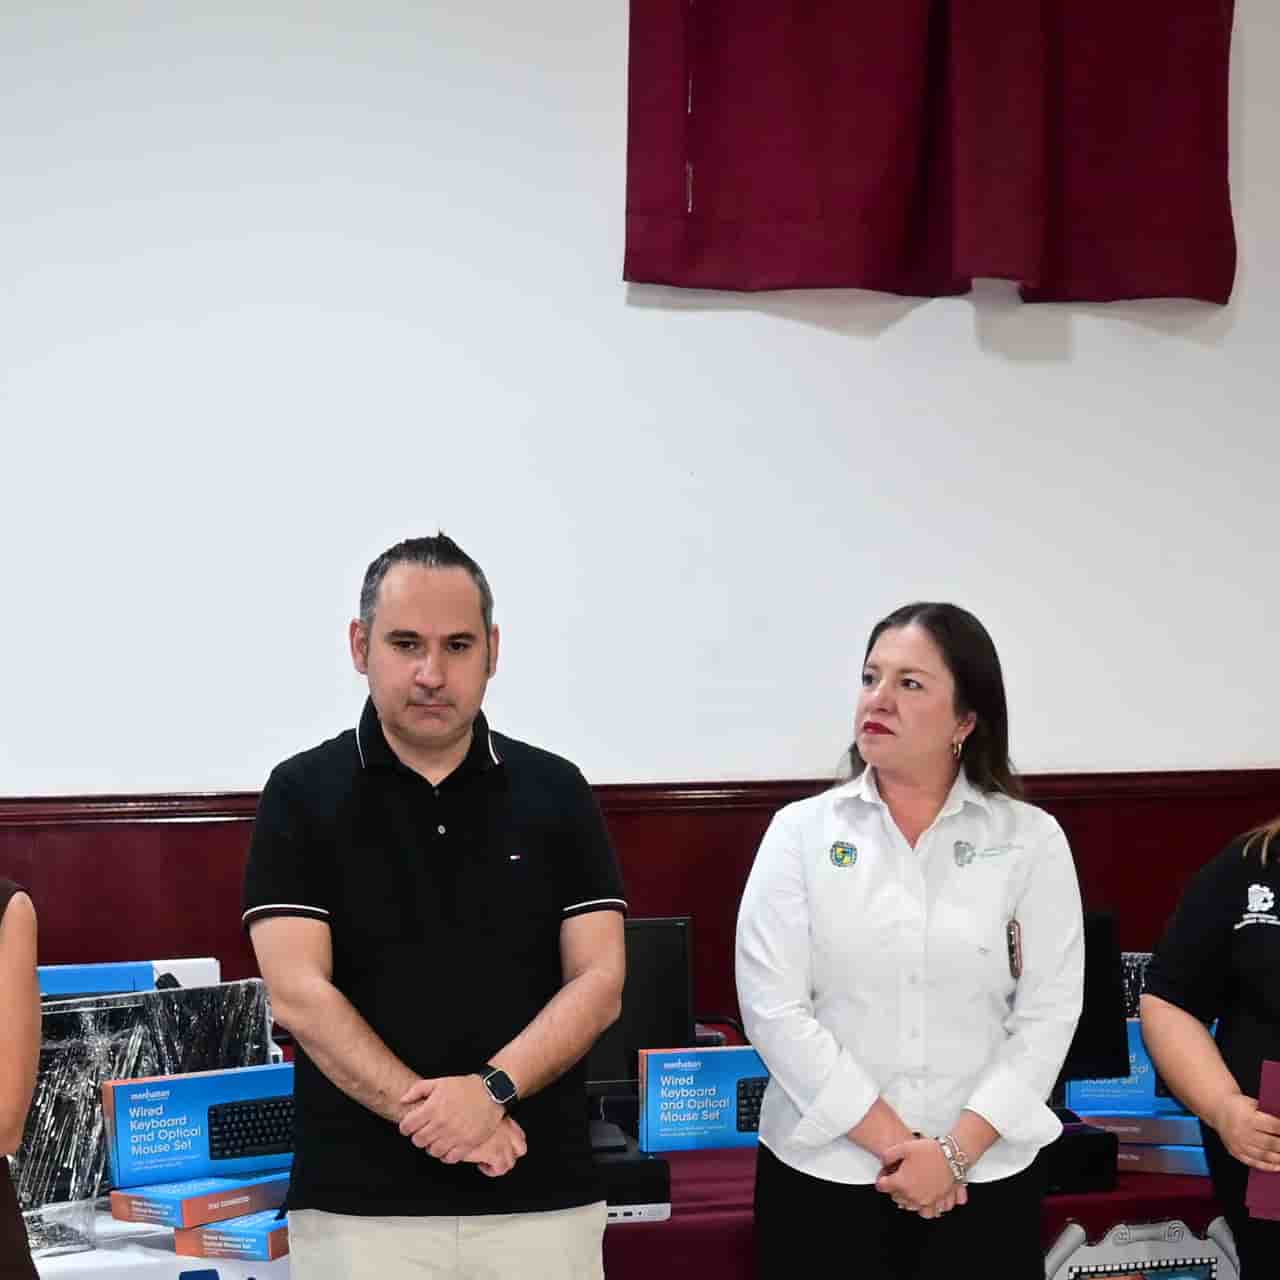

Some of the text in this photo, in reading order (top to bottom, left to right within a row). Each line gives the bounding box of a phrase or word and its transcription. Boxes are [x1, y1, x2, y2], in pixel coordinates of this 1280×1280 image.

[660, 1075, 694, 1087] Wired
[660, 1085, 716, 1099] Keyboard
[661, 1096, 730, 1110] and Optical
[128, 1104, 163, 1118] Wired
[660, 1109, 720, 1123] Mouse Set
[130, 1114, 187, 1131] Keyboard
[131, 1126, 200, 1143] and Optical
[131, 1139, 192, 1156] Mouse Set
